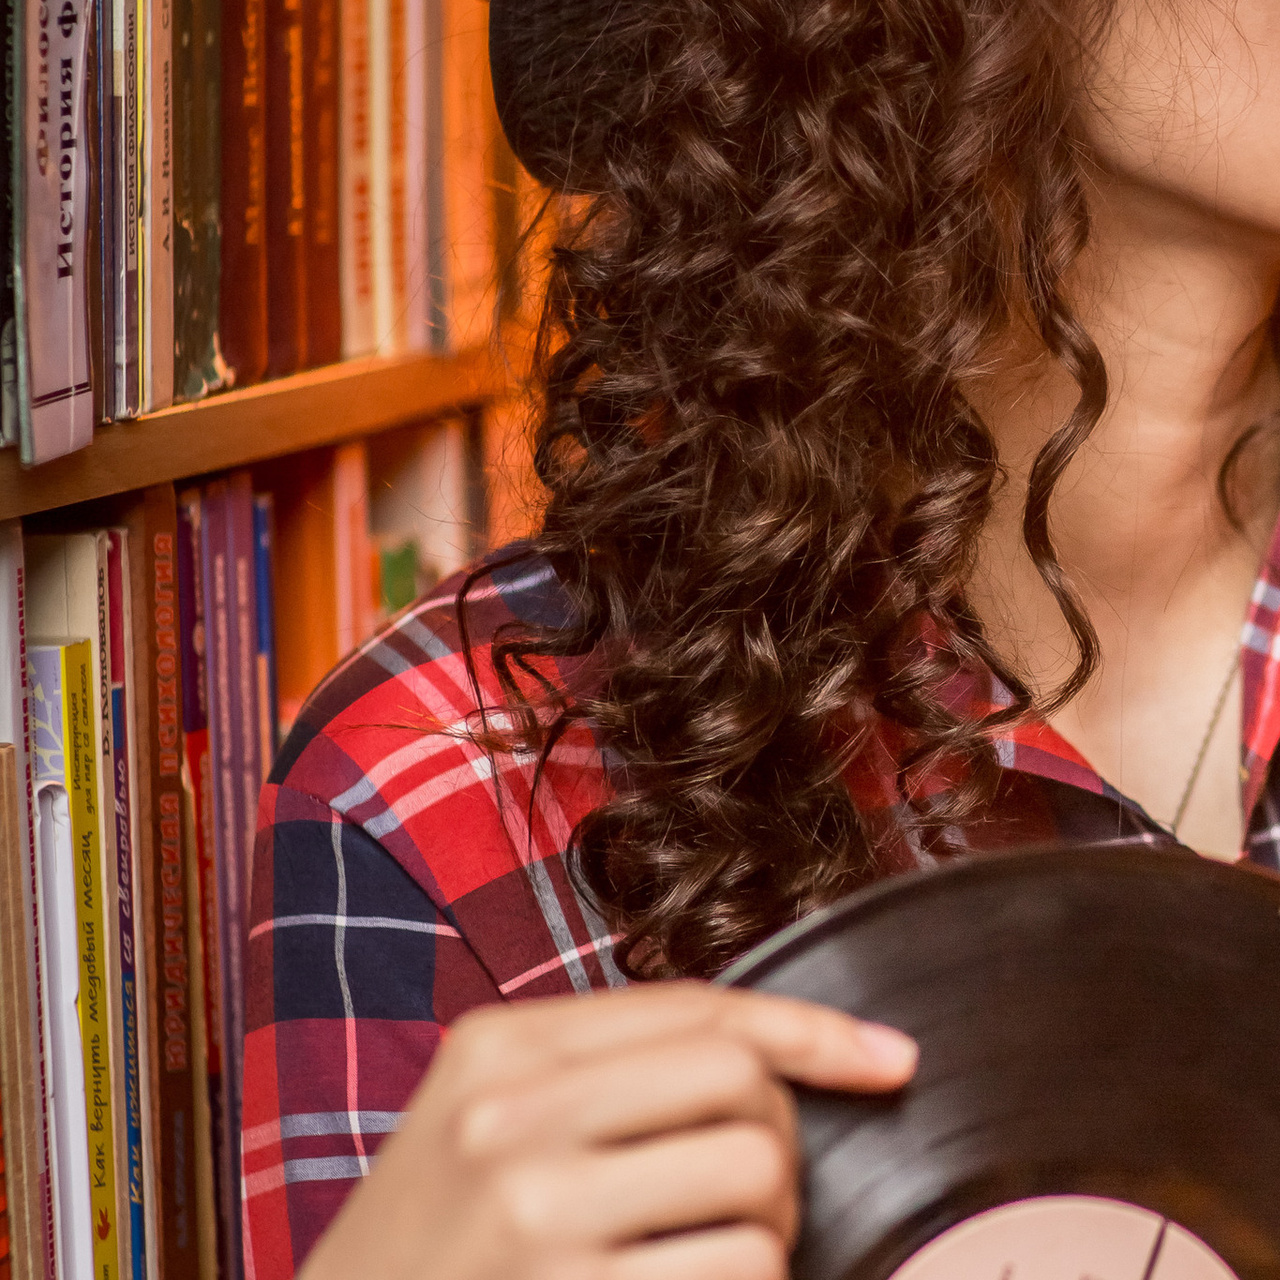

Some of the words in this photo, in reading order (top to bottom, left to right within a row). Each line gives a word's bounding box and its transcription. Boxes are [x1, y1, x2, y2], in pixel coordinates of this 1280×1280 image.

[56, 58, 77, 279] История
[80, 664, 88, 727] стажем
[154, 533, 178, 776] ПСИХОЛОГИЯ
[71, 693, 81, 790] Инструкция
[84, 754, 93, 782] пар
[85, 788, 95, 815] для
[115, 758, 131, 918] свекровью
[82, 922, 100, 1023] медовый
[122, 931, 133, 965] со
[160, 793, 186, 1071] ЮРИДИЧЕСКАЯ
[90, 1035, 107, 1131] вернуть
[124, 980, 141, 1129] ужиться
[93, 1143, 106, 1188] Как
[129, 1144, 142, 1204] Как
